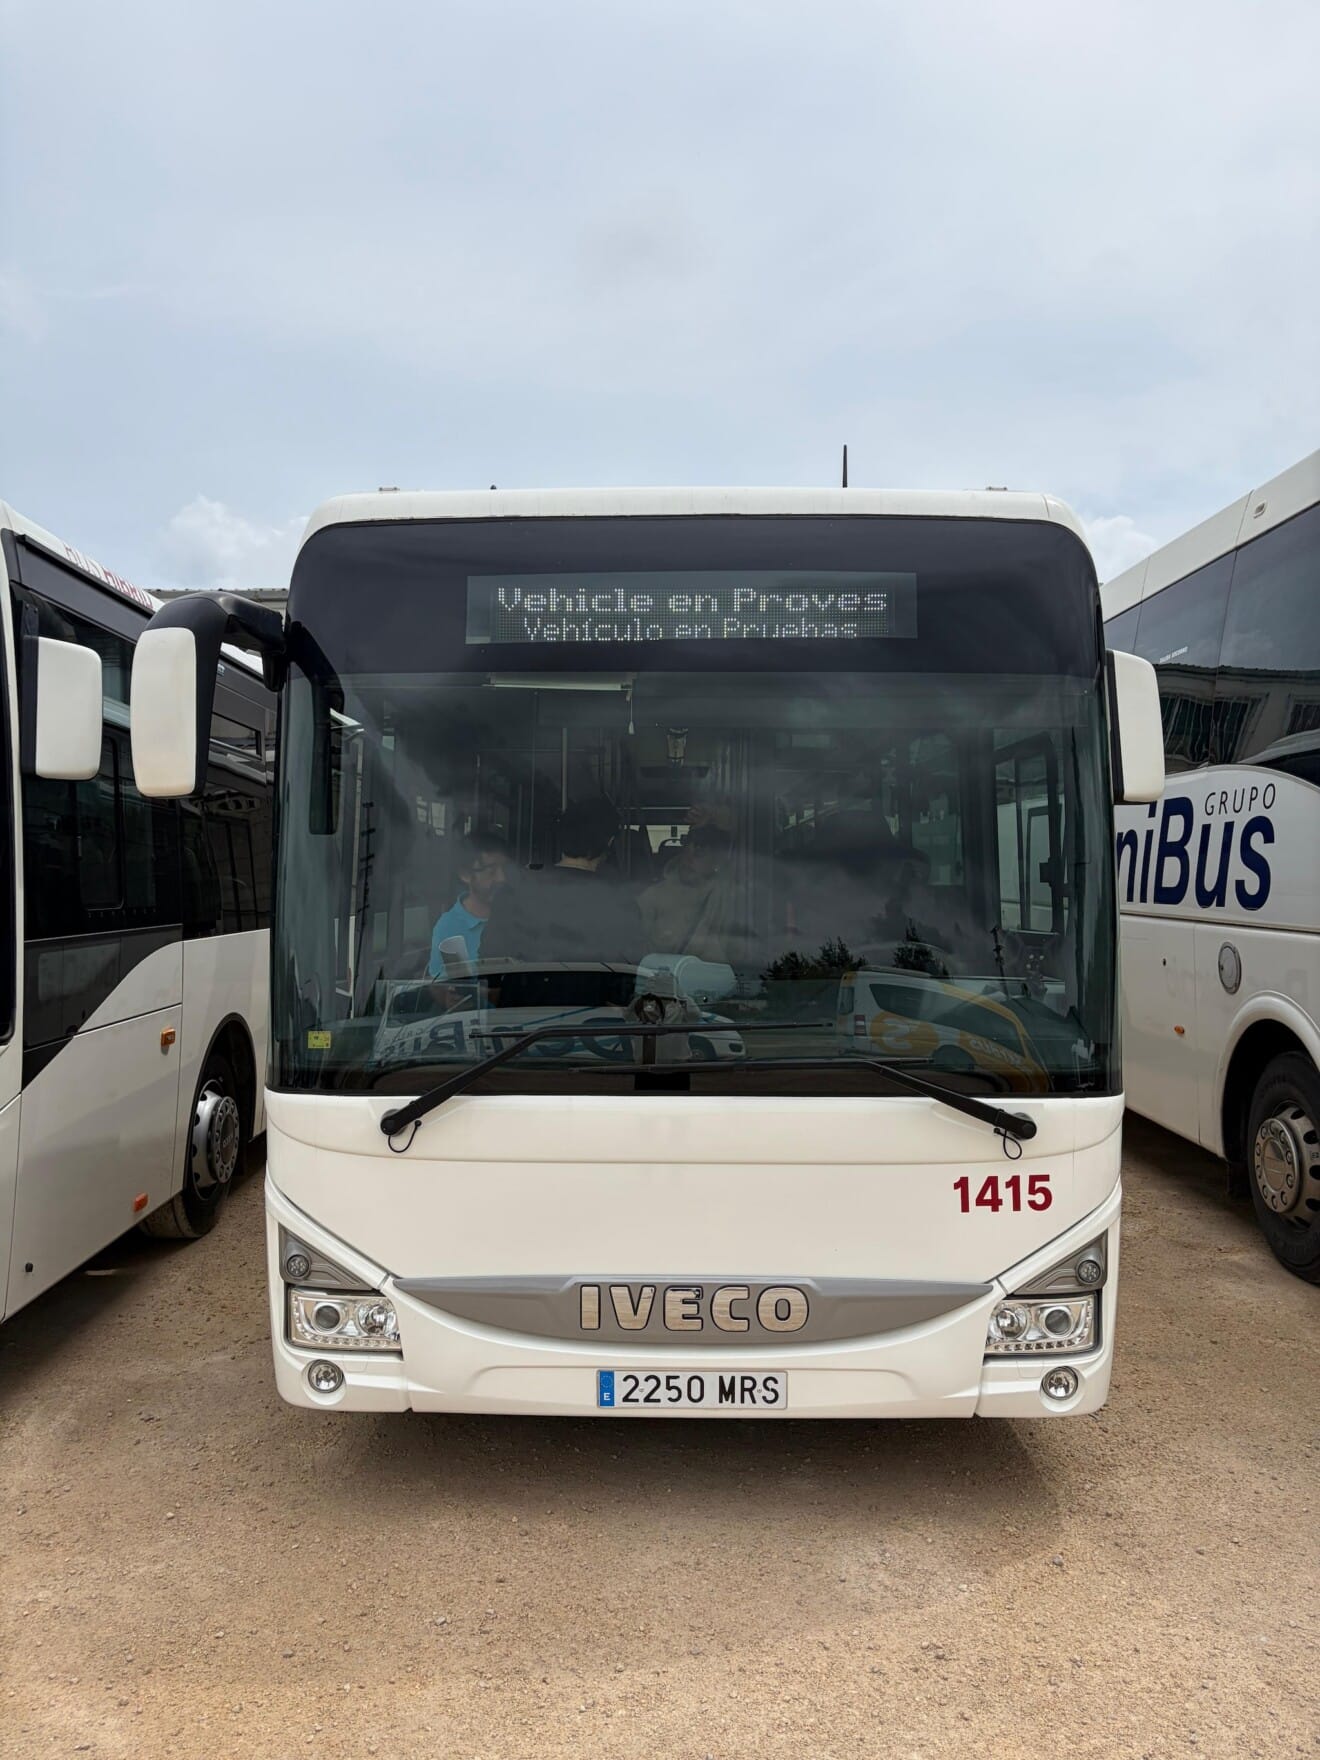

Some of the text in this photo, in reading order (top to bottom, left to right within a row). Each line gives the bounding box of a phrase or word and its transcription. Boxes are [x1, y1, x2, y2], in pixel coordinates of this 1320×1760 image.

[498, 587, 888, 612] Vehicle en Proves
[523, 617, 663, 641] Vehículo
[675, 624, 711, 639] en
[1204, 783, 1276, 816] GRUPO
[953, 1174, 1053, 1213] 1415
[579, 1284, 810, 1332] IVECO
[603, 1374, 780, 1404] E 2250 MRS
